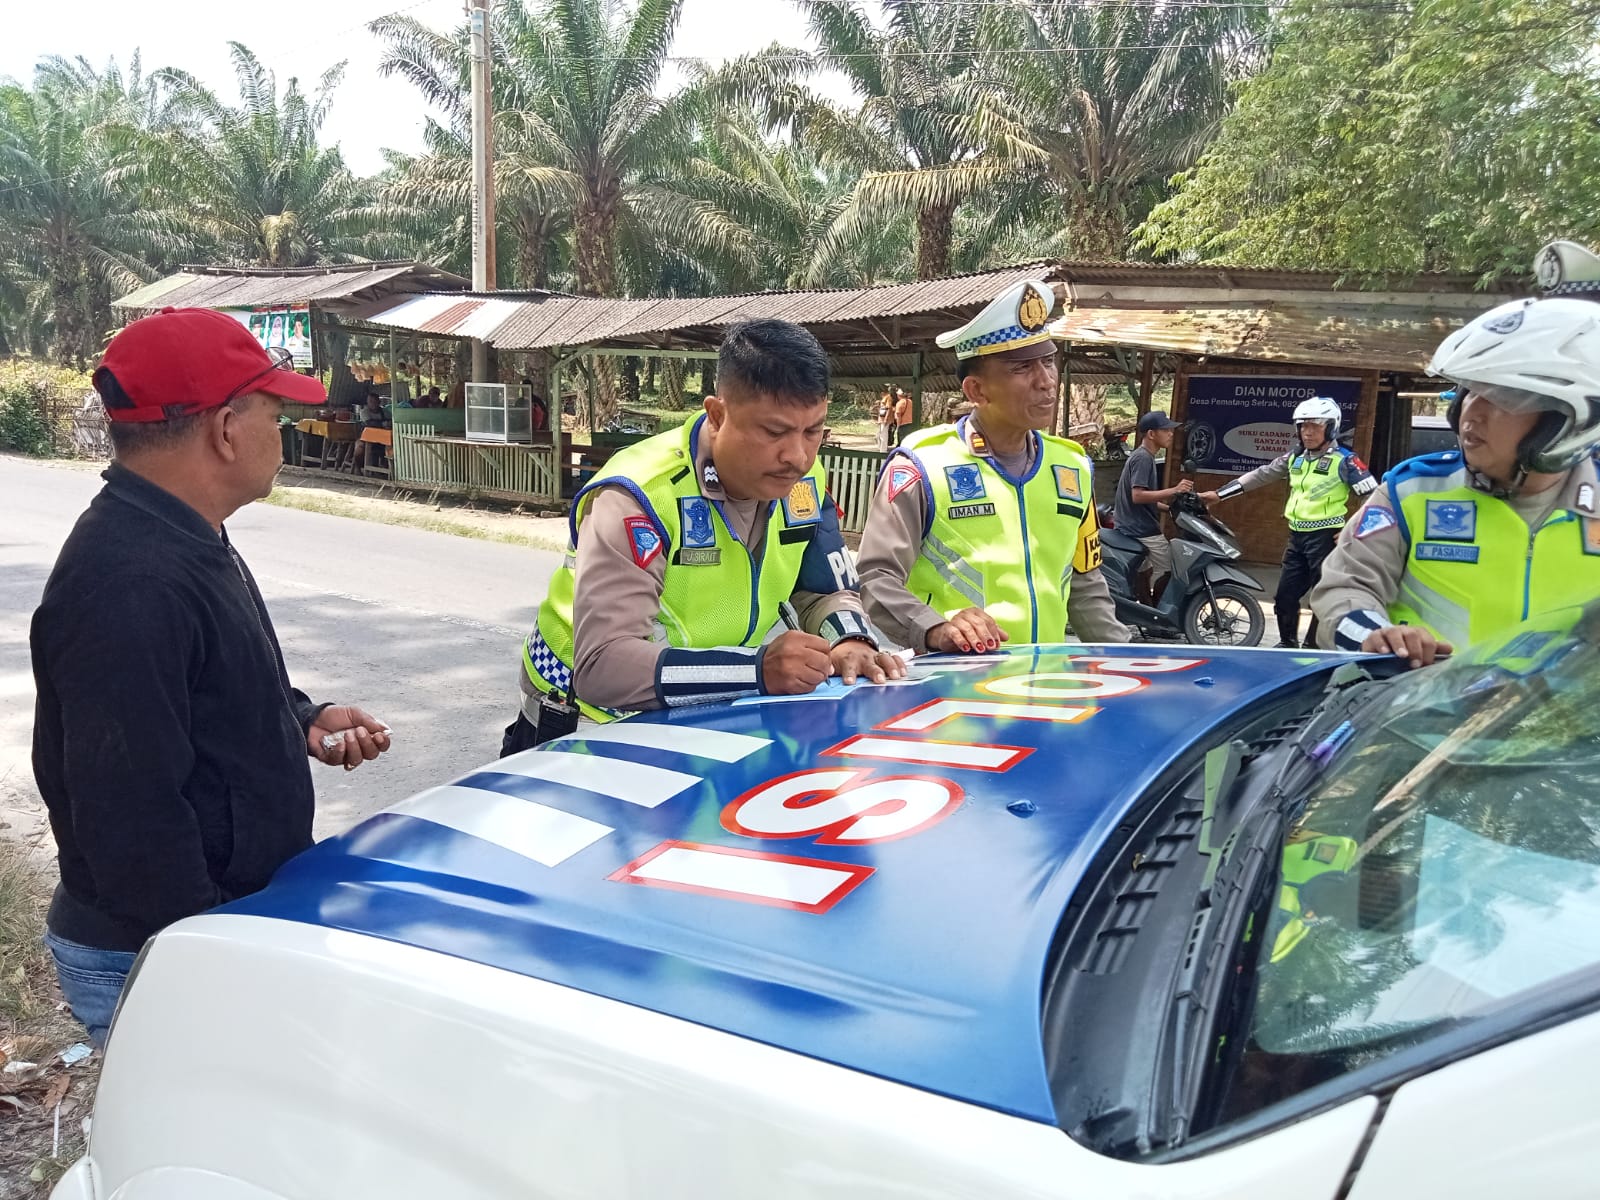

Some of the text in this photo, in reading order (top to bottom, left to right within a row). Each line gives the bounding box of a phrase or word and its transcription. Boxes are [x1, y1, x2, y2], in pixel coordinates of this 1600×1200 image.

[1235, 386, 1316, 398] DIAN MOTOR
[1190, 397, 1209, 405] Desa
[1211, 398, 1250, 408] Pematang
[954, 504, 992, 517] IMAN M
[606, 655, 1210, 915] POLISI
